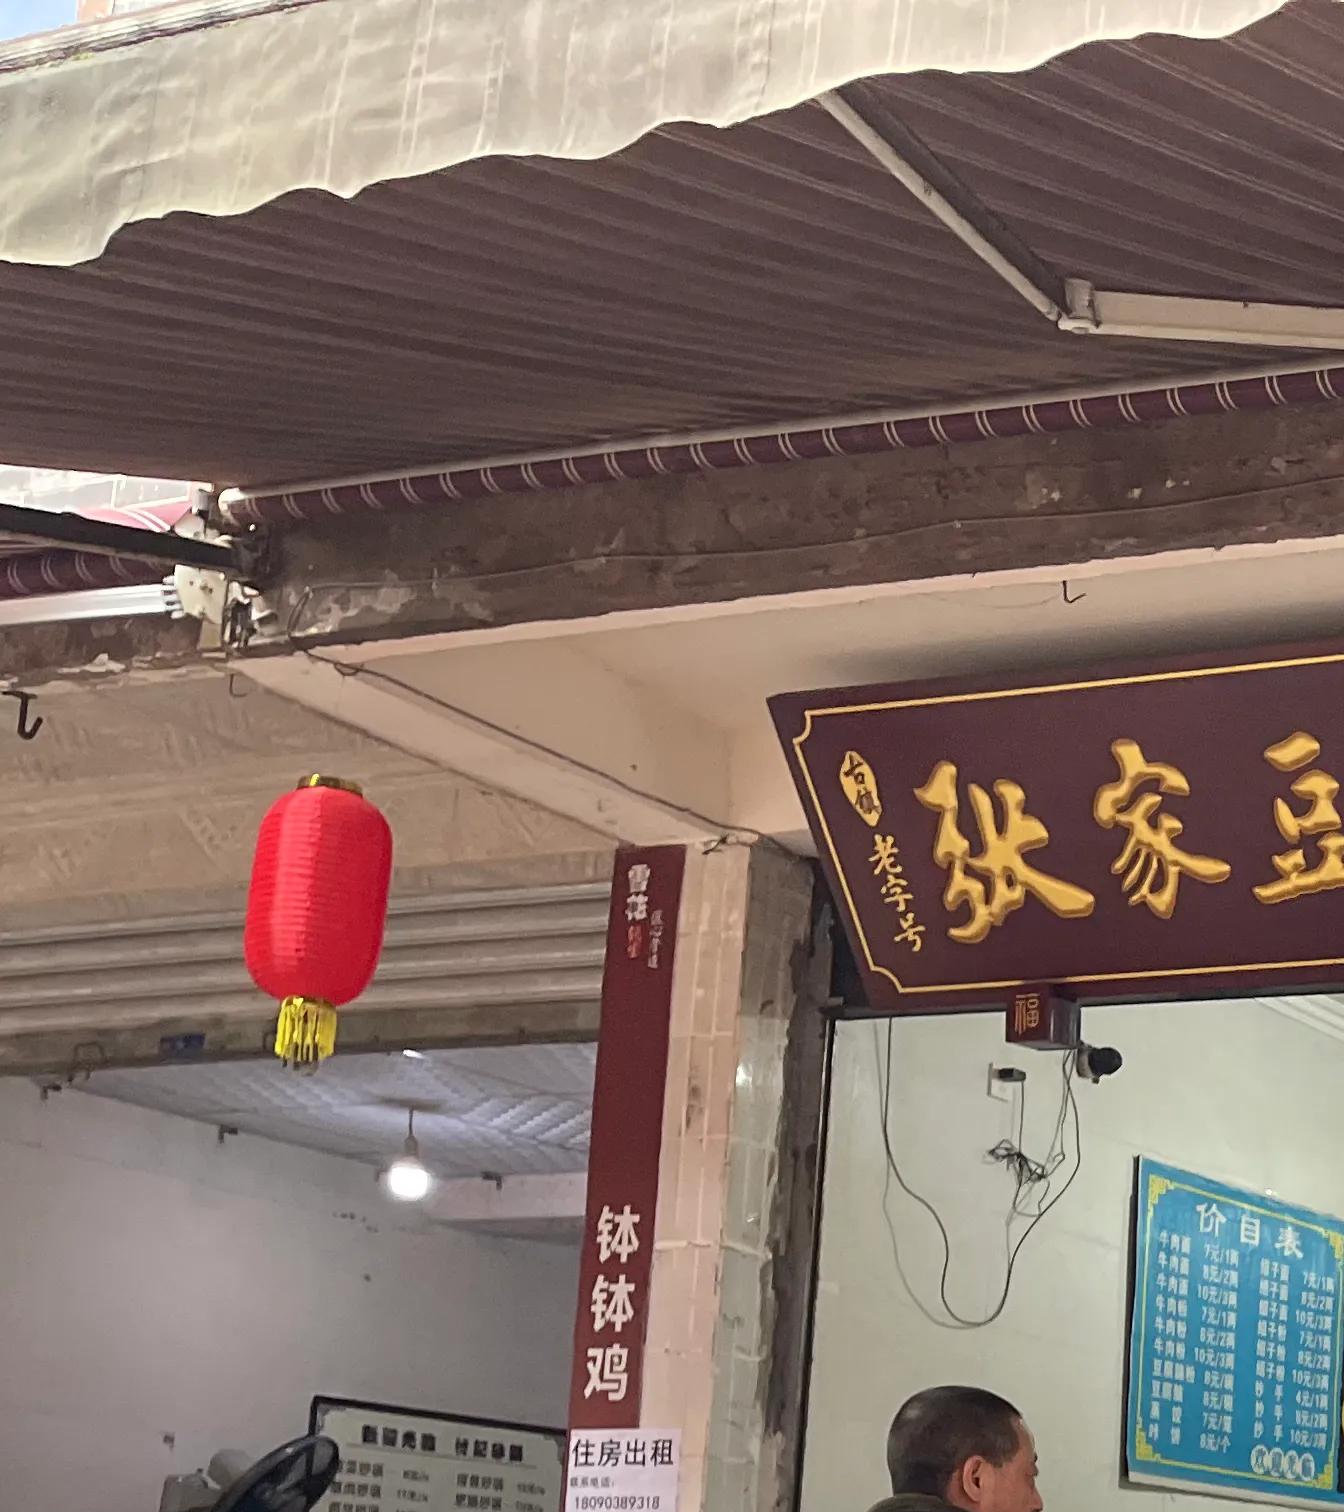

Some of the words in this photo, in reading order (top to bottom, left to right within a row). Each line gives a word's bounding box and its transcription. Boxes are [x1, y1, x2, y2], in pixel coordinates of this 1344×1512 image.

[868, 833, 926, 952] 老字号
[1196, 1203, 1303, 1259] 价目表
[583, 1205, 640, 1401] 钵钵鸡
[571, 1438, 674, 1467] 住房出租
[575, 1495, 660, 1510] 18090389318
